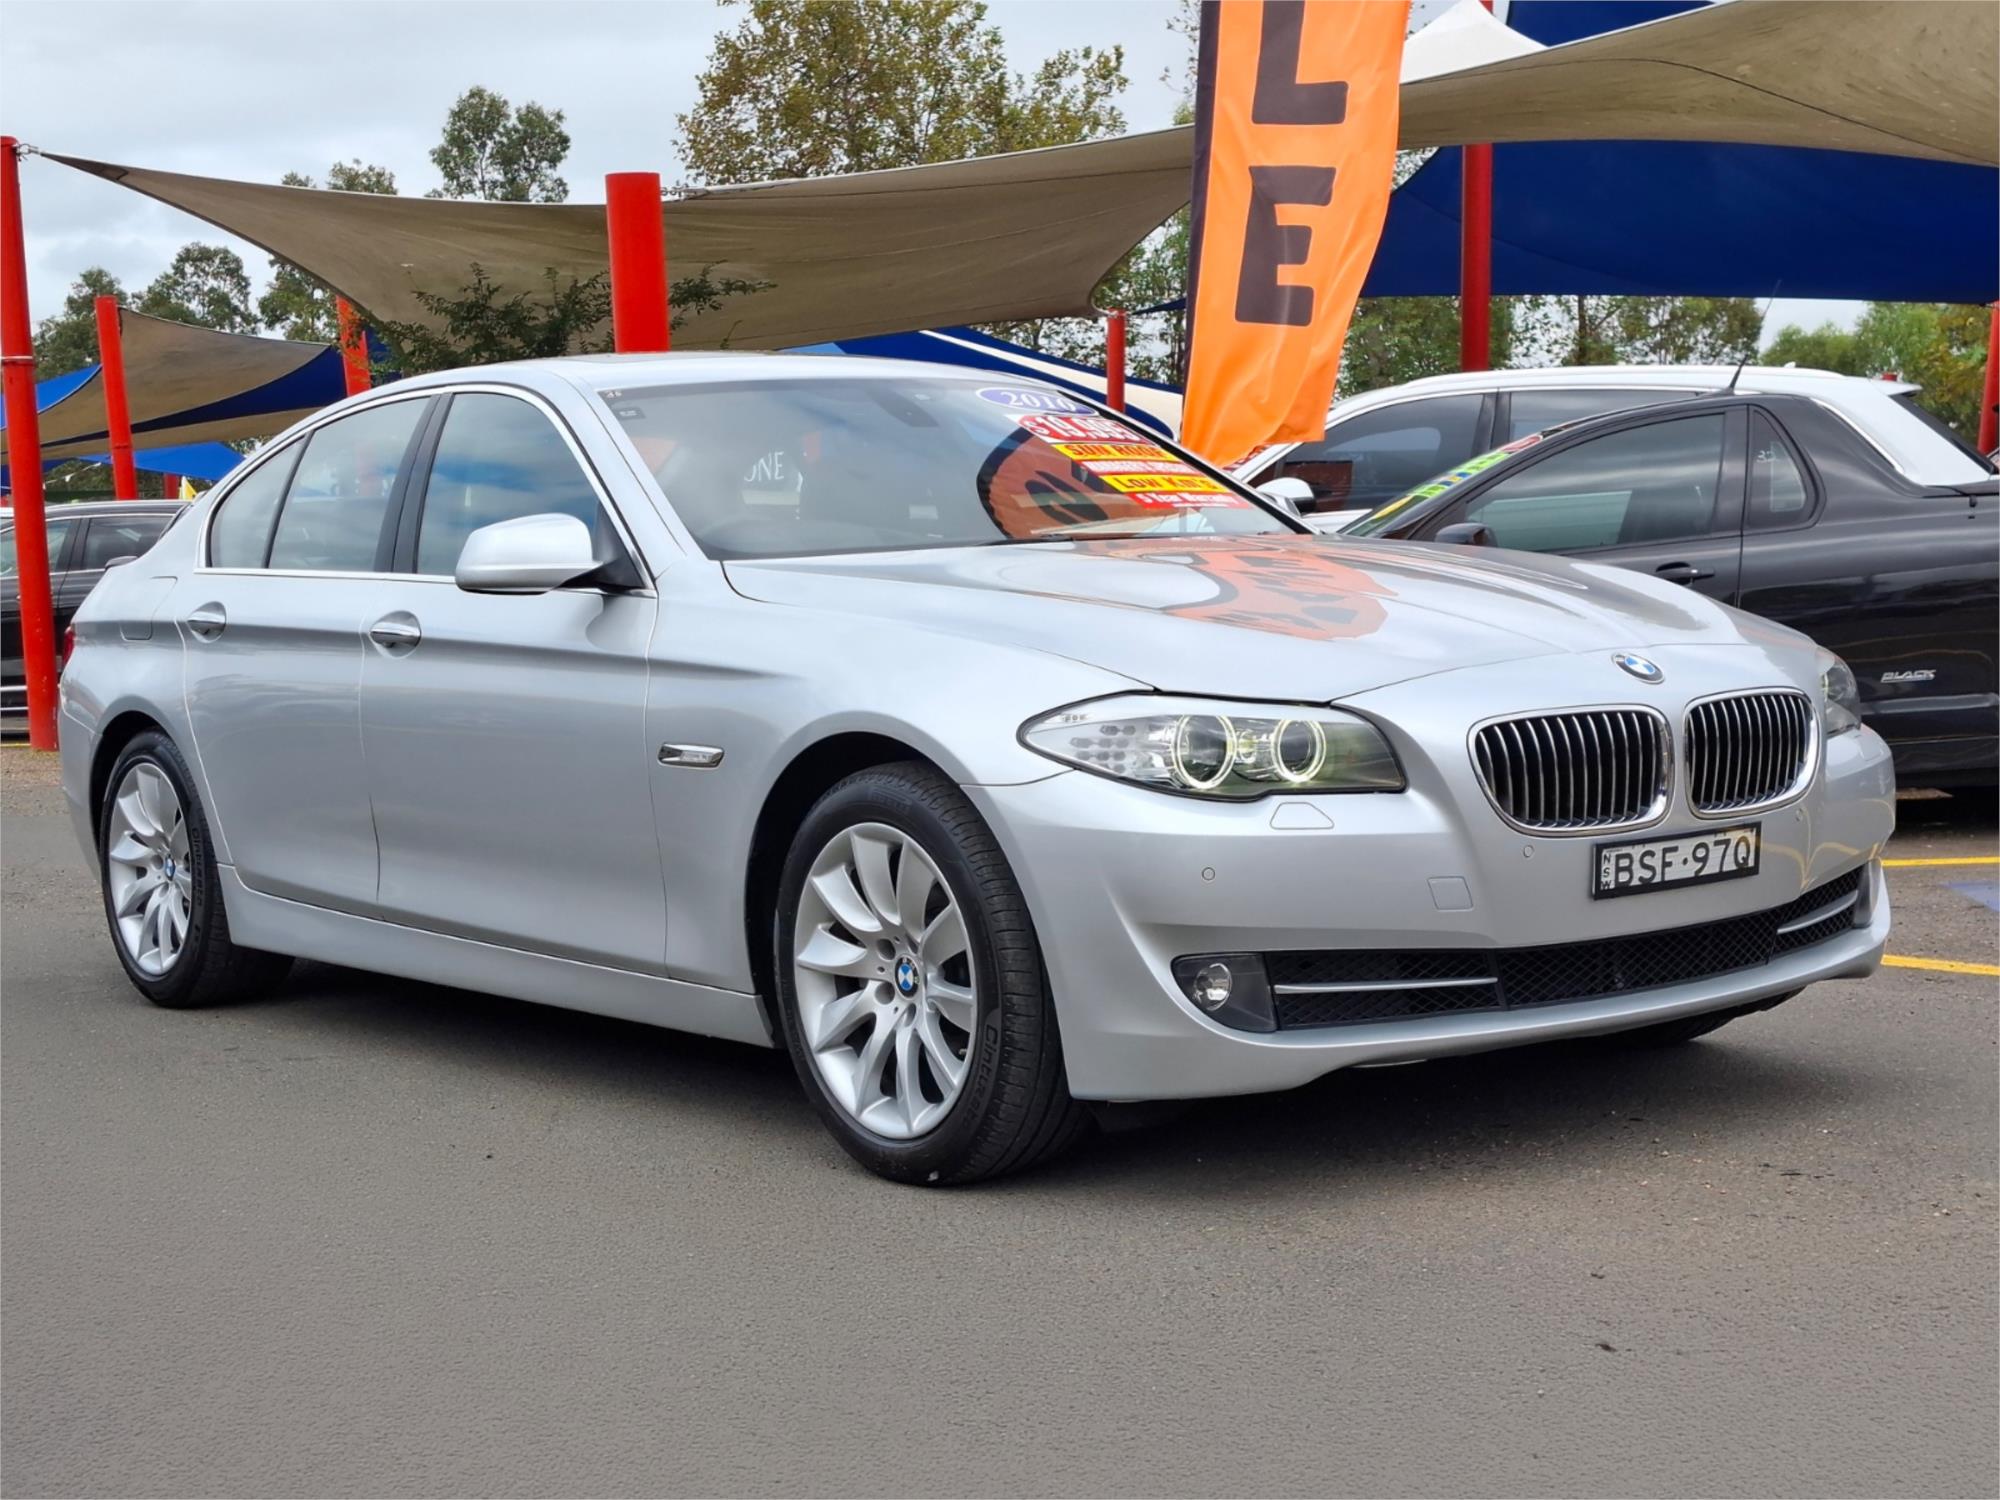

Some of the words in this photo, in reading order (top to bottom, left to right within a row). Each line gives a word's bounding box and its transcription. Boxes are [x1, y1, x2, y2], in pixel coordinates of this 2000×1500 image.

[1000, 391, 1077, 412] 2010
[1064, 443, 1109, 456] SUN
[1880, 669, 1936, 683] BLACK
